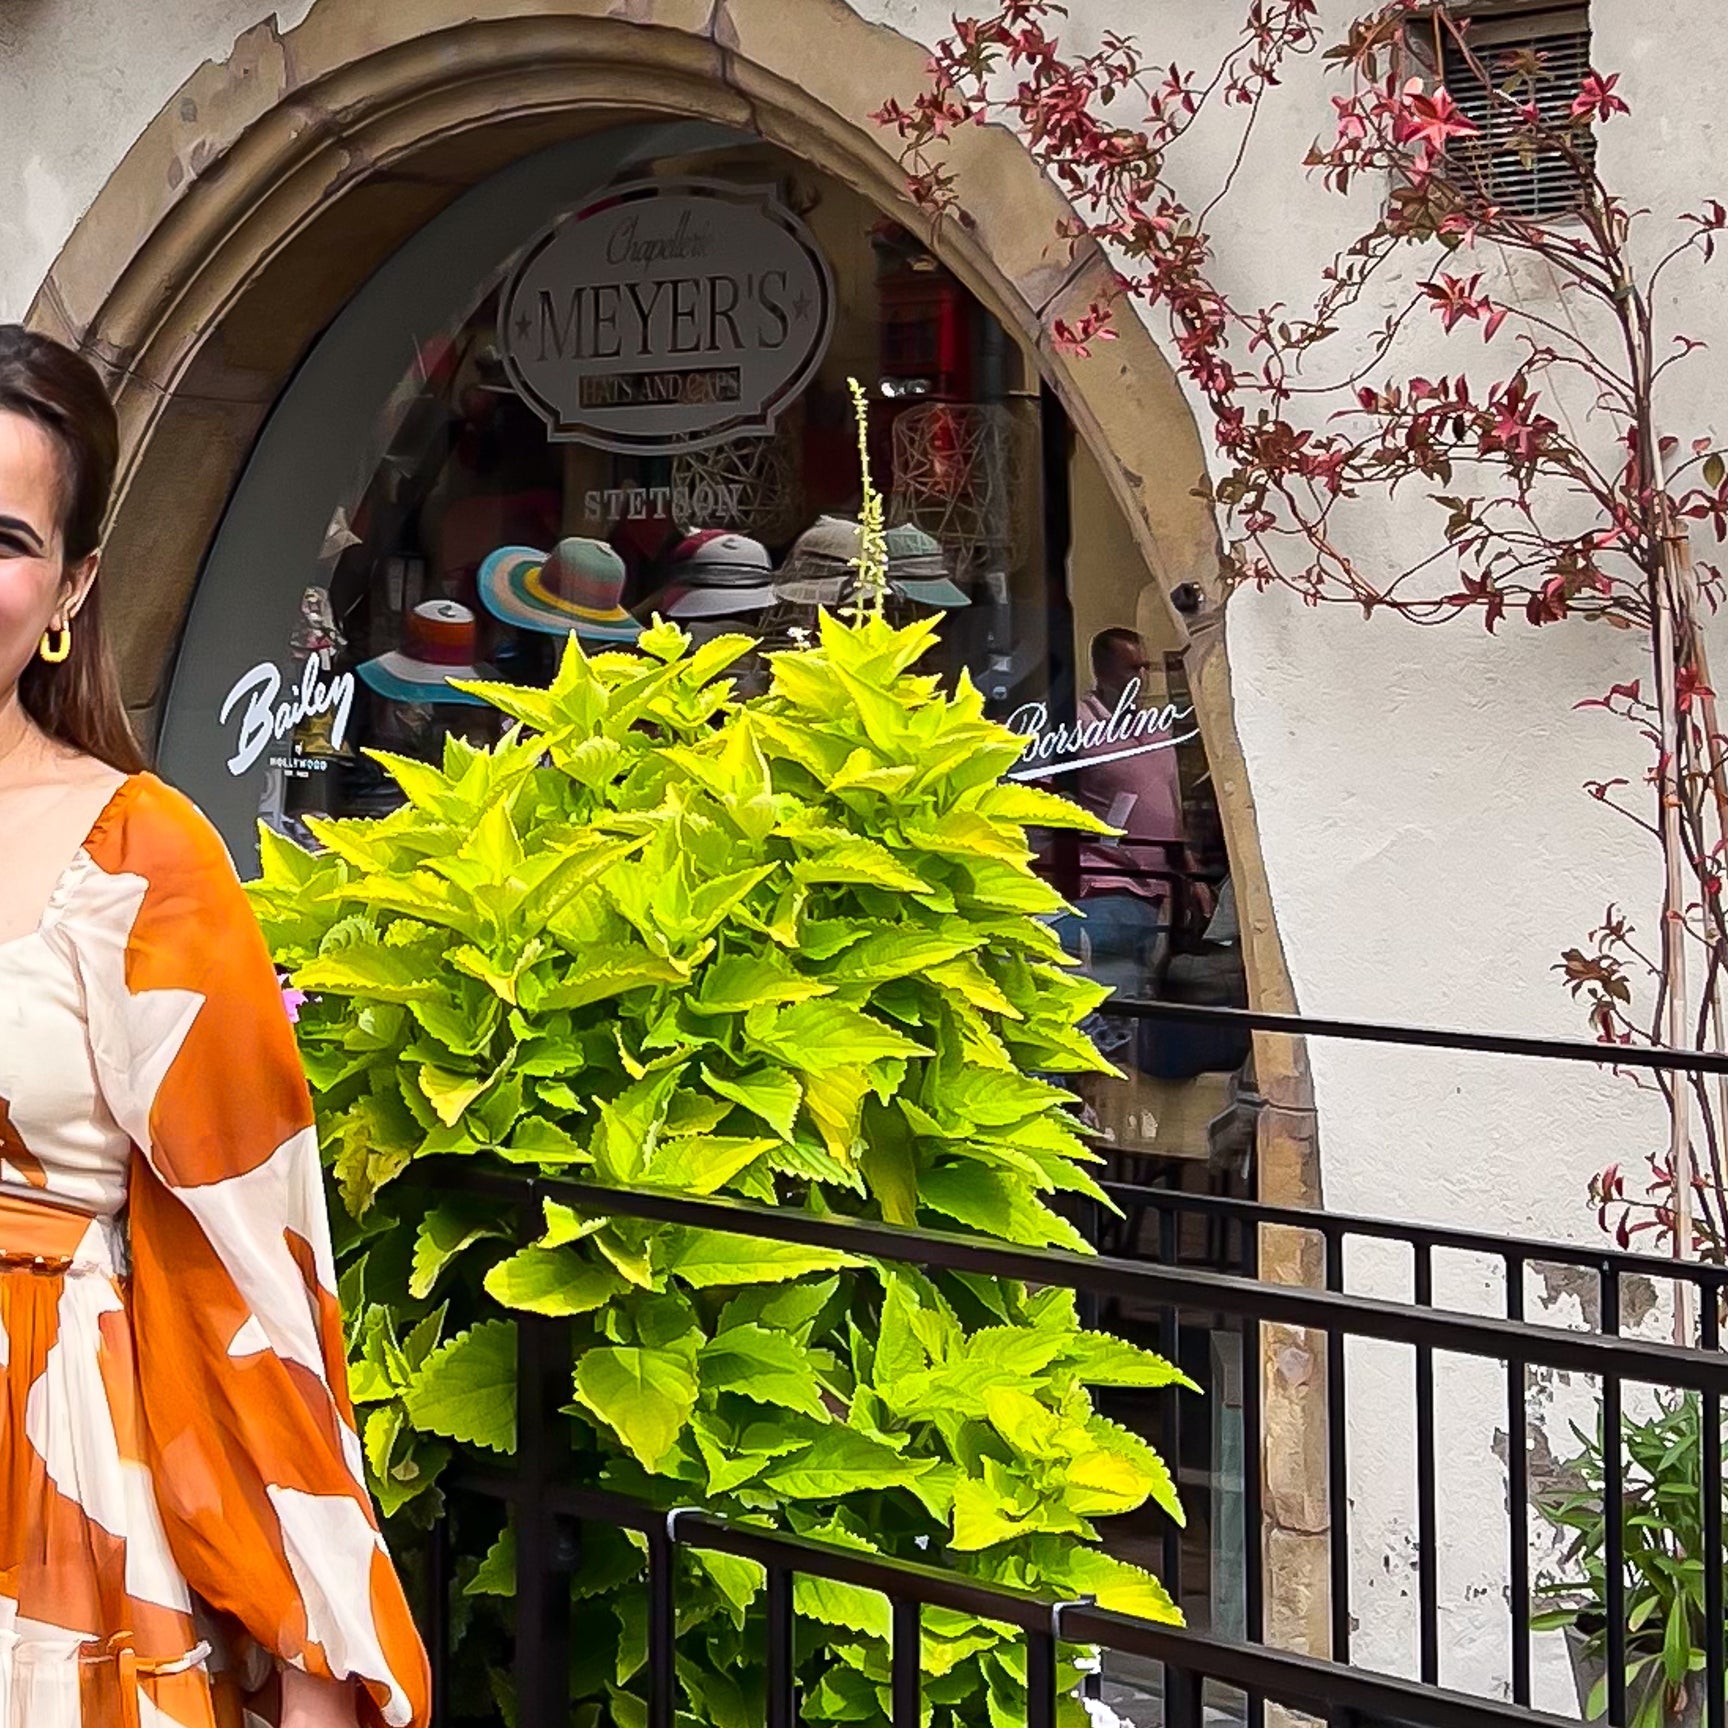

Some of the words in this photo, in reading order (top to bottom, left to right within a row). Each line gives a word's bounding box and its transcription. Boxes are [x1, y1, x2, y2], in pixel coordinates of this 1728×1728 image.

[536, 270, 790, 362] MEYER'S
[639, 374, 683, 401] AND
[583, 484, 744, 520] STETSON
[219, 651, 355, 776] Bailey
[1007, 676, 1195, 762] Borsalino
